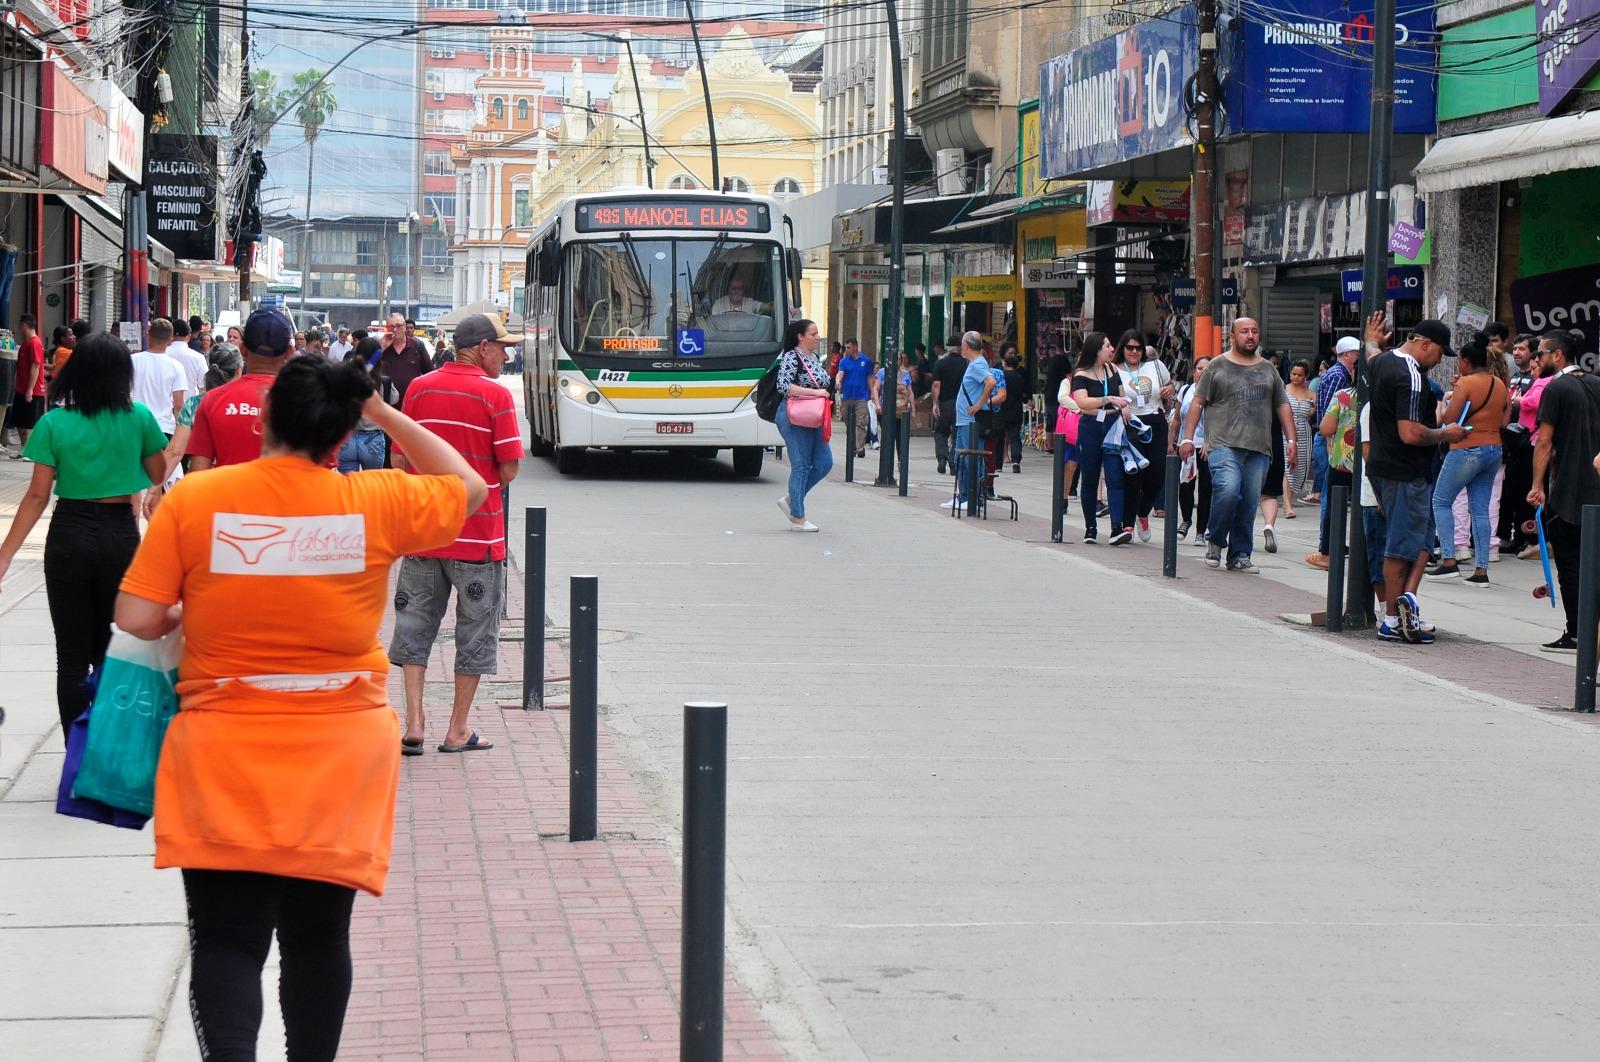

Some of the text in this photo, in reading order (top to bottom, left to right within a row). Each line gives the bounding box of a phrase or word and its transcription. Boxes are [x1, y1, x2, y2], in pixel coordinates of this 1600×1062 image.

[1264, 23, 1342, 44] PRIORIDADE
[1063, 49, 1171, 153] PRIORIDADE 10
[148, 160, 210, 175] CALÇADOS
[152, 185, 206, 198] MASCULINO
[156, 201, 201, 214] FEMININO
[624, 207, 693, 226] MANOEL
[700, 207, 748, 226] ELIAS
[158, 218, 199, 231] INFANTIL
[1398, 223, 1418, 238] bem
[1394, 232, 1409, 242] me
[1391, 239, 1411, 252] quer
[1403, 276, 1418, 288] 10
[1174, 287, 1197, 297] PRIORID
[603, 338, 659, 350] PROTASIO
[601, 372, 626, 382] 4422
